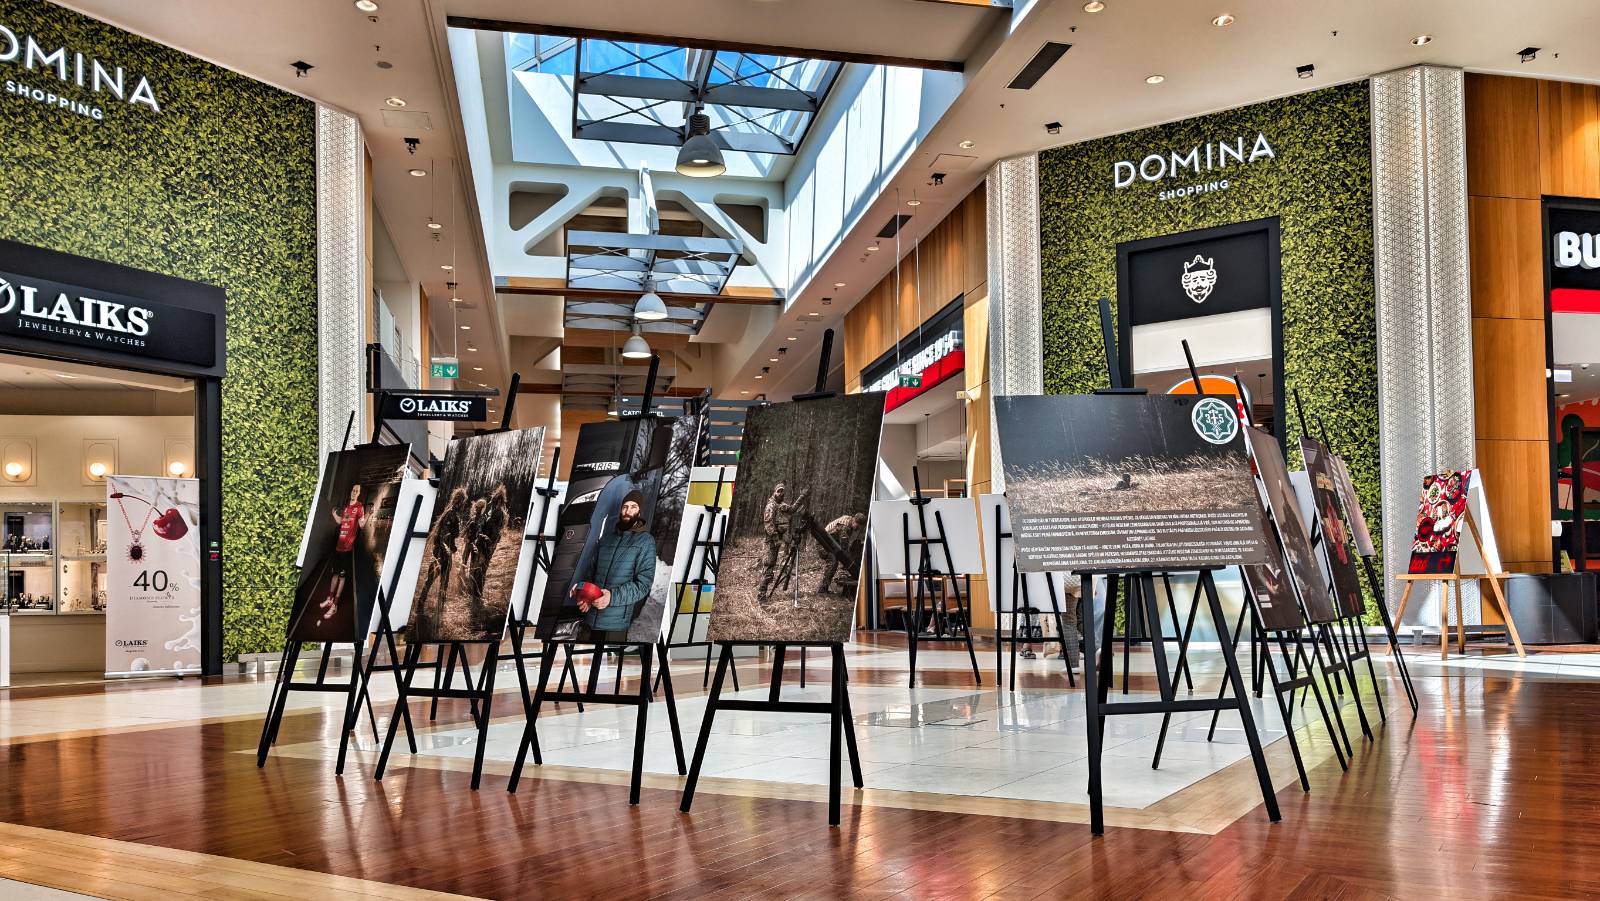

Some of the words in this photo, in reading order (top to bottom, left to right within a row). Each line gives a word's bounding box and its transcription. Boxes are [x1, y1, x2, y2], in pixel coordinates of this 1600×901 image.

[5, 80, 104, 120] SHOPPING
[1114, 132, 1276, 188] DOMINA
[1159, 179, 1229, 201] SHOPPING
[18, 318, 82, 337] JEWELLERY
[95, 331, 146, 347] WATCHES
